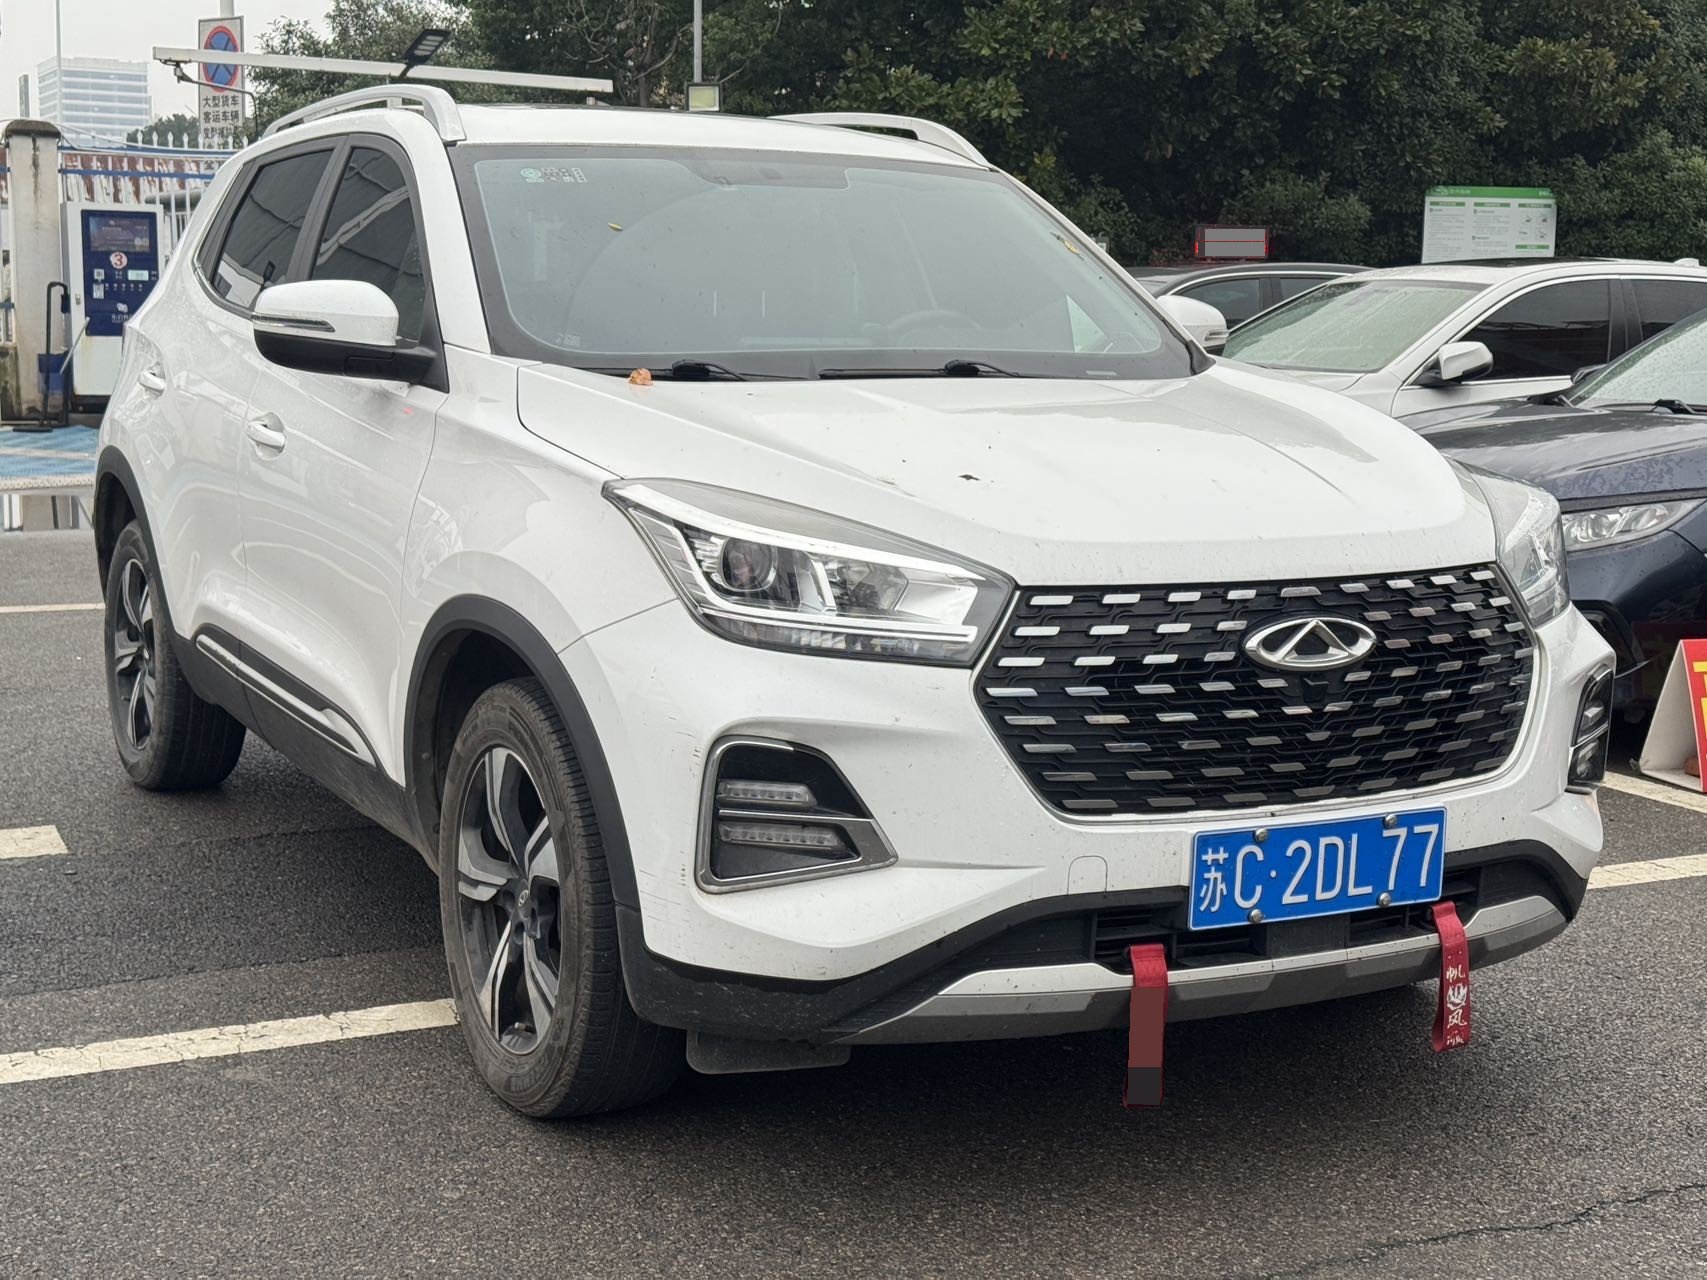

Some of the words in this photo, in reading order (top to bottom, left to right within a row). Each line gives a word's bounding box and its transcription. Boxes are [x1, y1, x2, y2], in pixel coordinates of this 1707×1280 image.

[203, 95, 239, 108] 大型货车
[203, 110, 240, 124] 客运车辆
[114, 254, 123, 267] 3
[1199, 823, 1440, 913] 苏C·2DL77
